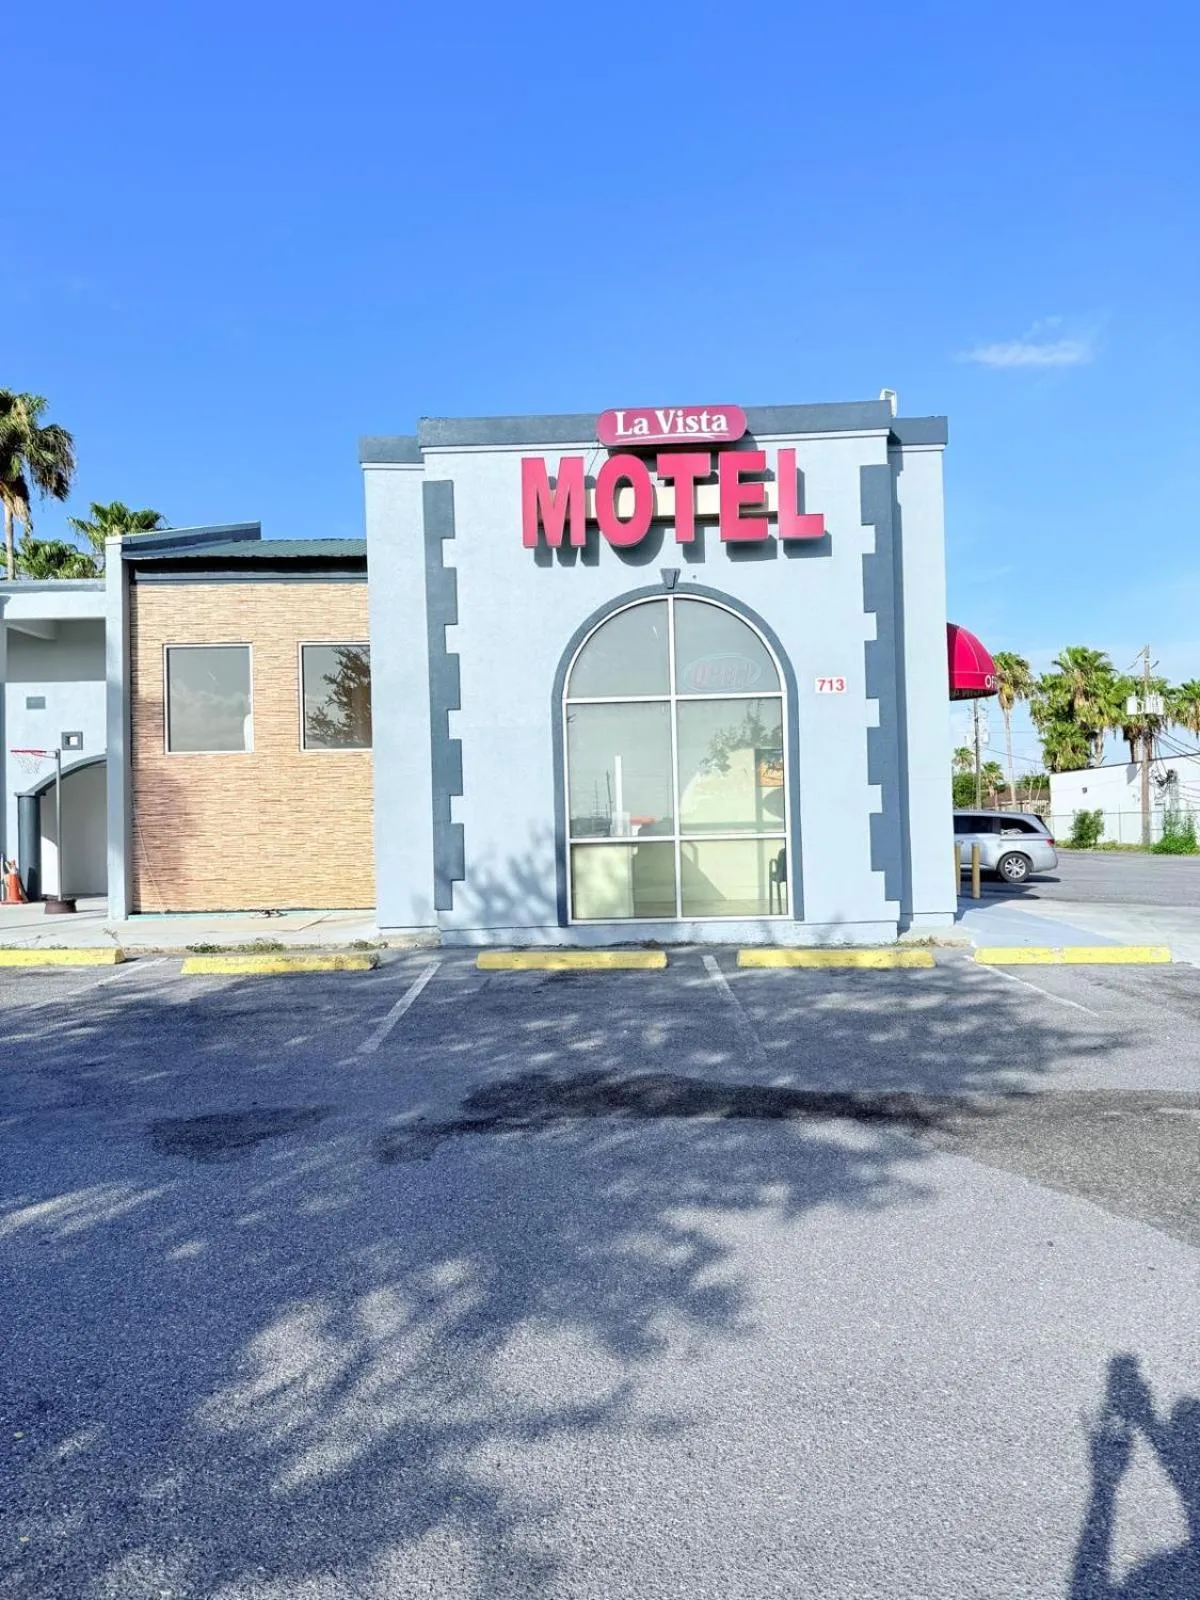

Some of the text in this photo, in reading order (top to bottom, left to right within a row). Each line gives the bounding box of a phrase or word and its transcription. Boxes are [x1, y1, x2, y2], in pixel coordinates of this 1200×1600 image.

[615, 409, 728, 436] La Vista
[521, 447, 825, 548] MOTEL
[817, 678, 845, 692] 713
